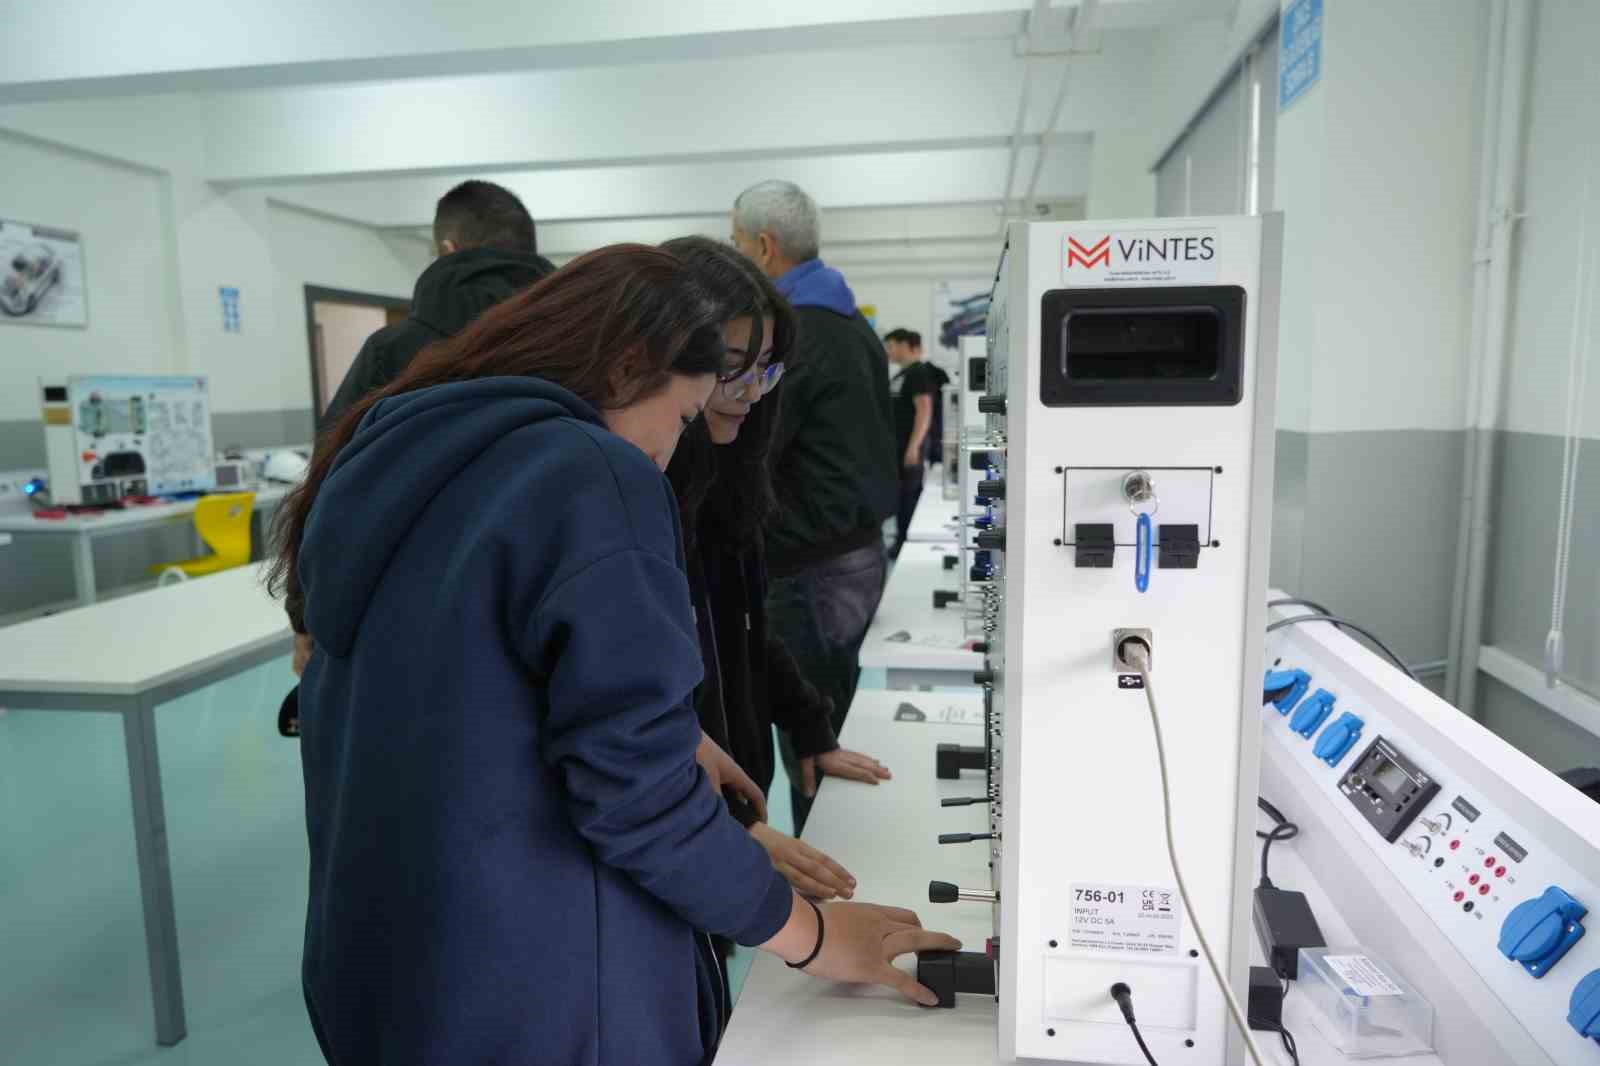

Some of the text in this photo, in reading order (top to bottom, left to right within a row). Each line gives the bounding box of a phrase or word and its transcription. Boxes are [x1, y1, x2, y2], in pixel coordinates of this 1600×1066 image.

[1118, 236, 1214, 262] ViNTES
[1075, 889, 1124, 904] 756-01
[1074, 907, 1099, 916] INPUT
[1074, 915, 1089, 924] 12V
[1104, 917, 1115, 925] 5A
